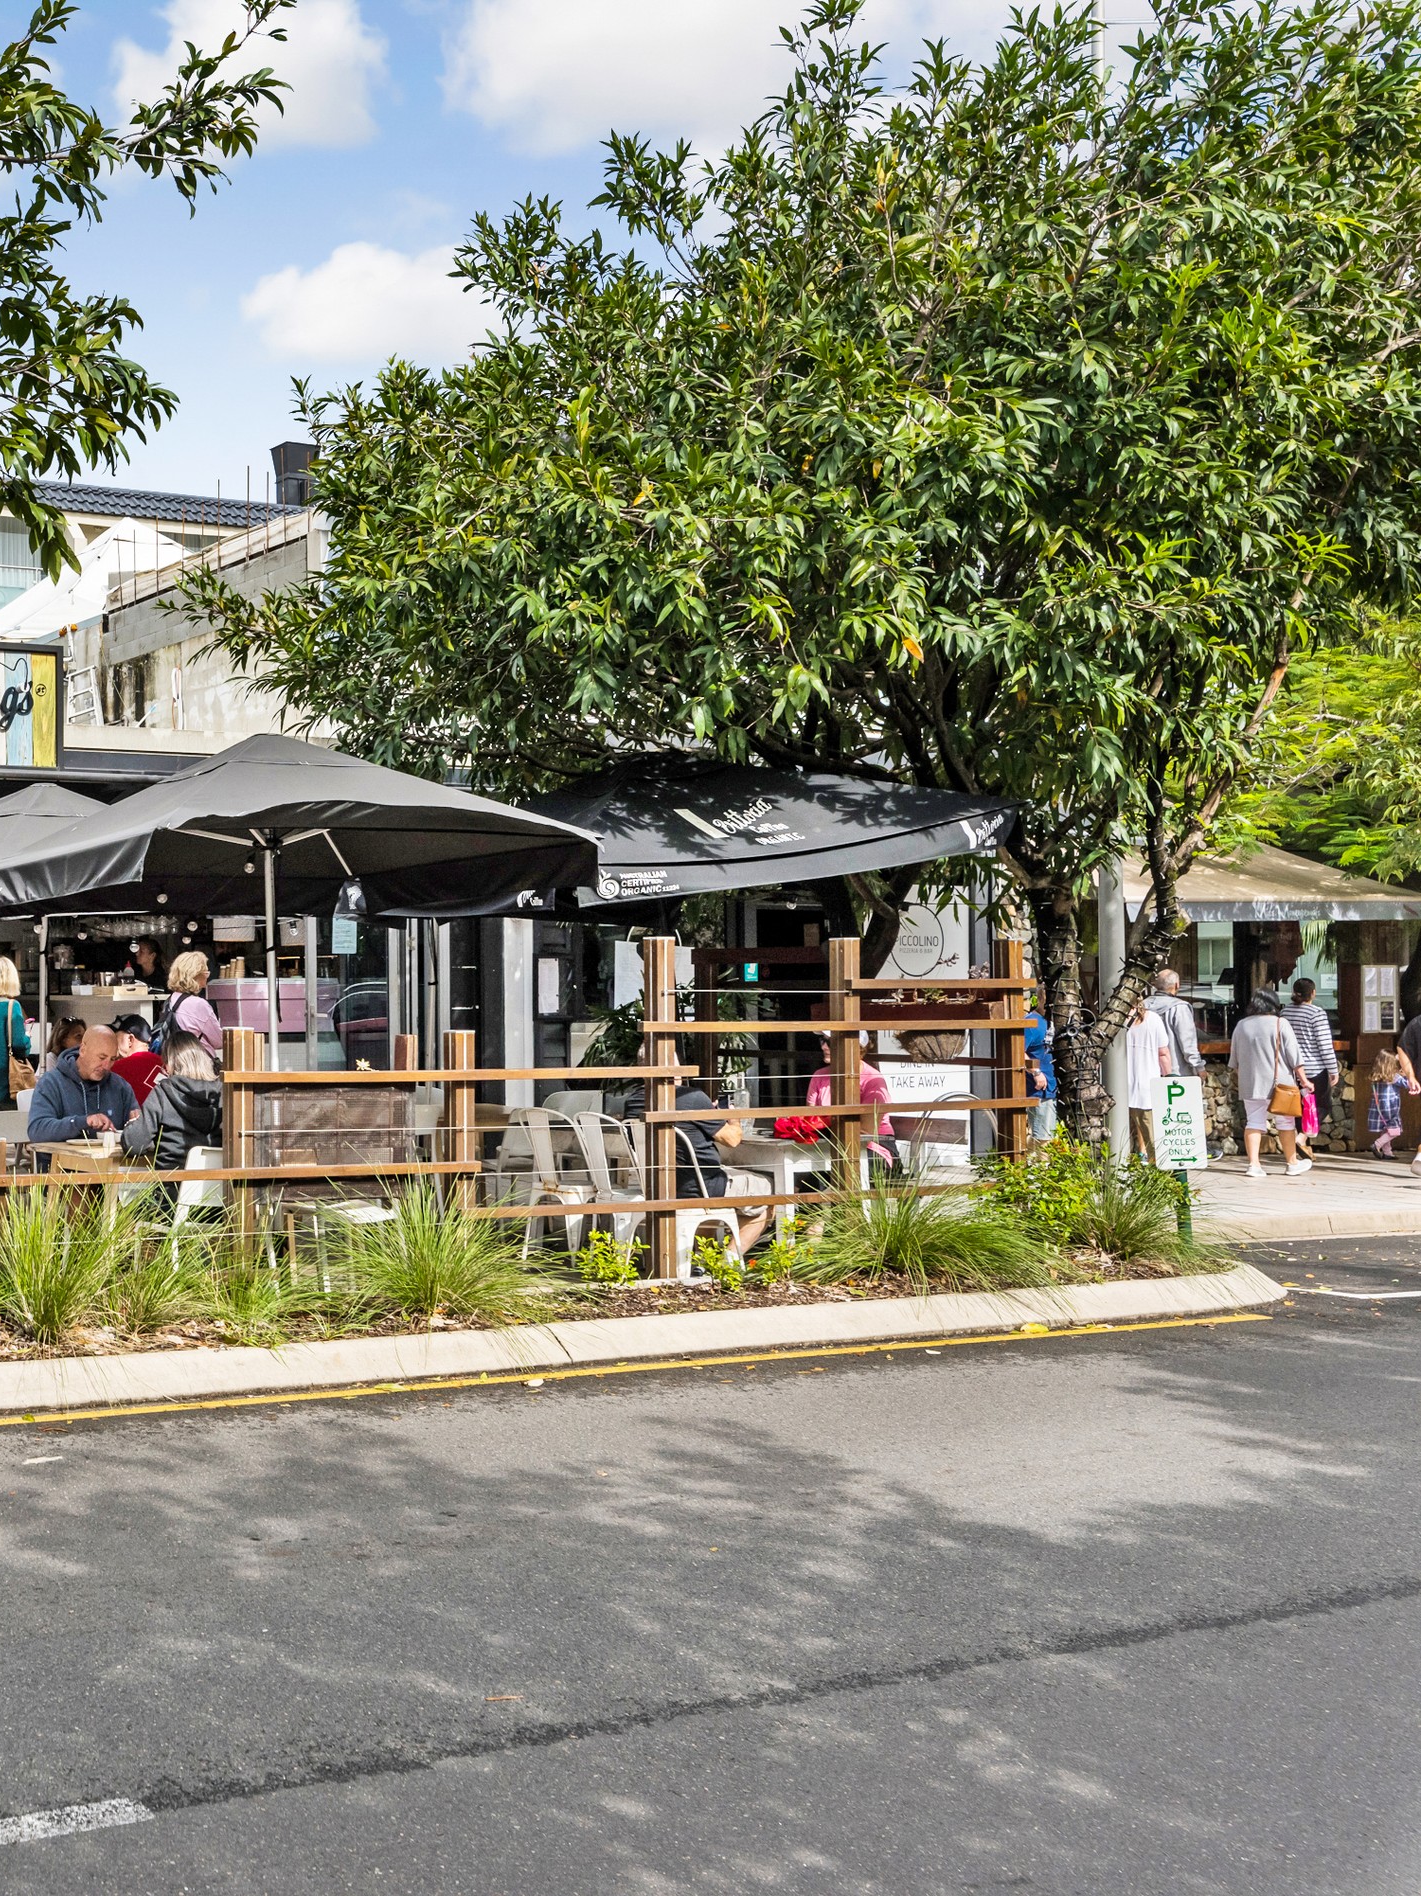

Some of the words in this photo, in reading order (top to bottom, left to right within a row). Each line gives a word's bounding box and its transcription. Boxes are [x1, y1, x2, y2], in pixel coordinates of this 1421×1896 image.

[712, 797, 773, 834] Vittoria
[621, 886, 662, 897] ORGANIC
[890, 1076, 915, 1088] TAKE
[918, 1075, 946, 1088] AWAY
[1167, 1085, 1185, 1105] P
[1163, 1138, 1195, 1146] CYCLES
